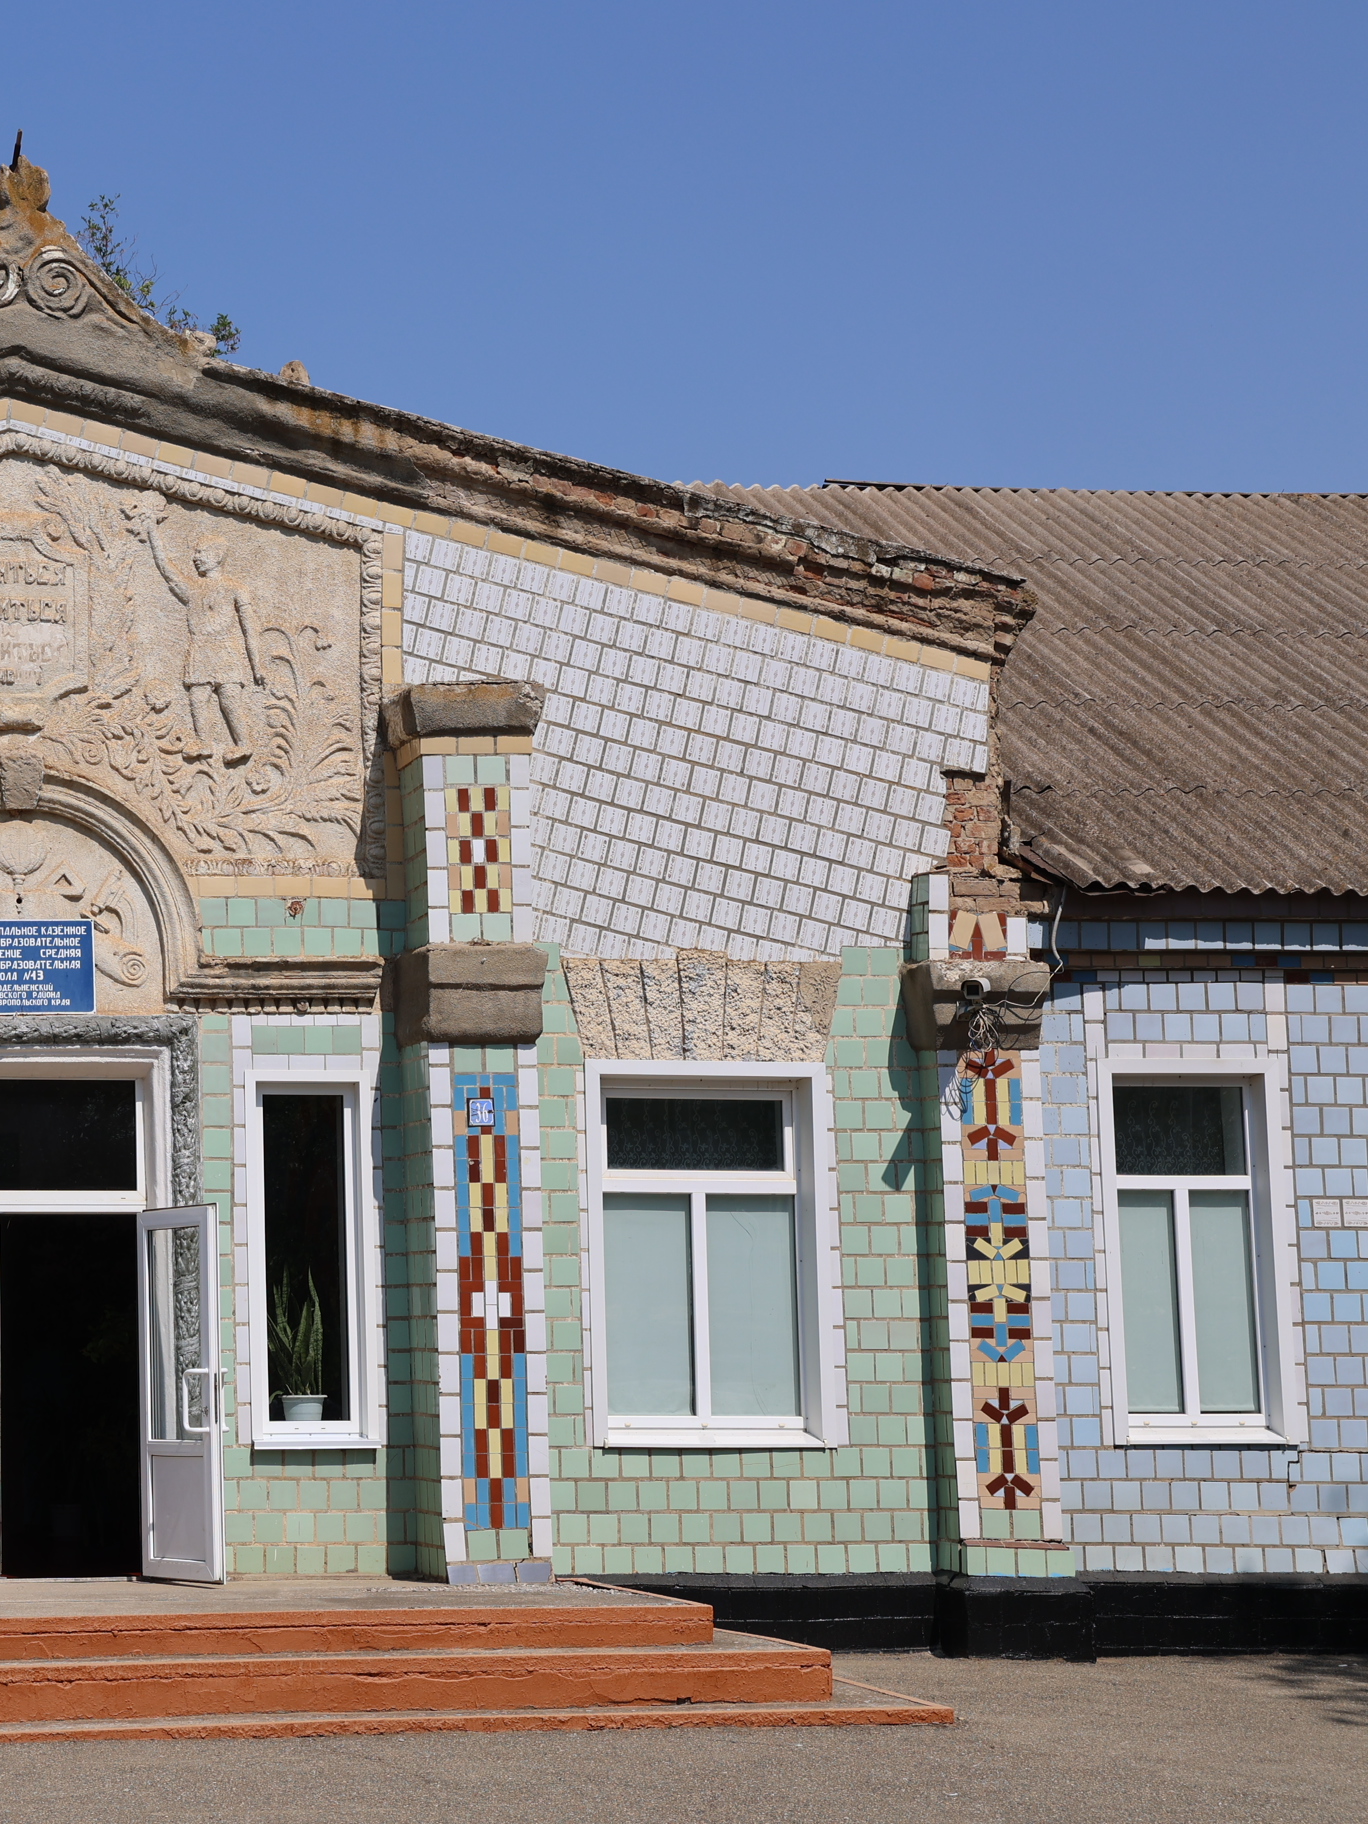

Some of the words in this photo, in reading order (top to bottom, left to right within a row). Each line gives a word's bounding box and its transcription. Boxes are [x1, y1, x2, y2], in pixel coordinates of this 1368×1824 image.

[41, 925, 87, 935] КАЗЁННОЕ
[40, 948, 82, 958] СРЕДНЯЯ
[32, 991, 61, 999] РАЙОНА
[51, 998, 71, 1006] КРАЯ
[475, 1102, 489, 1122] 36
